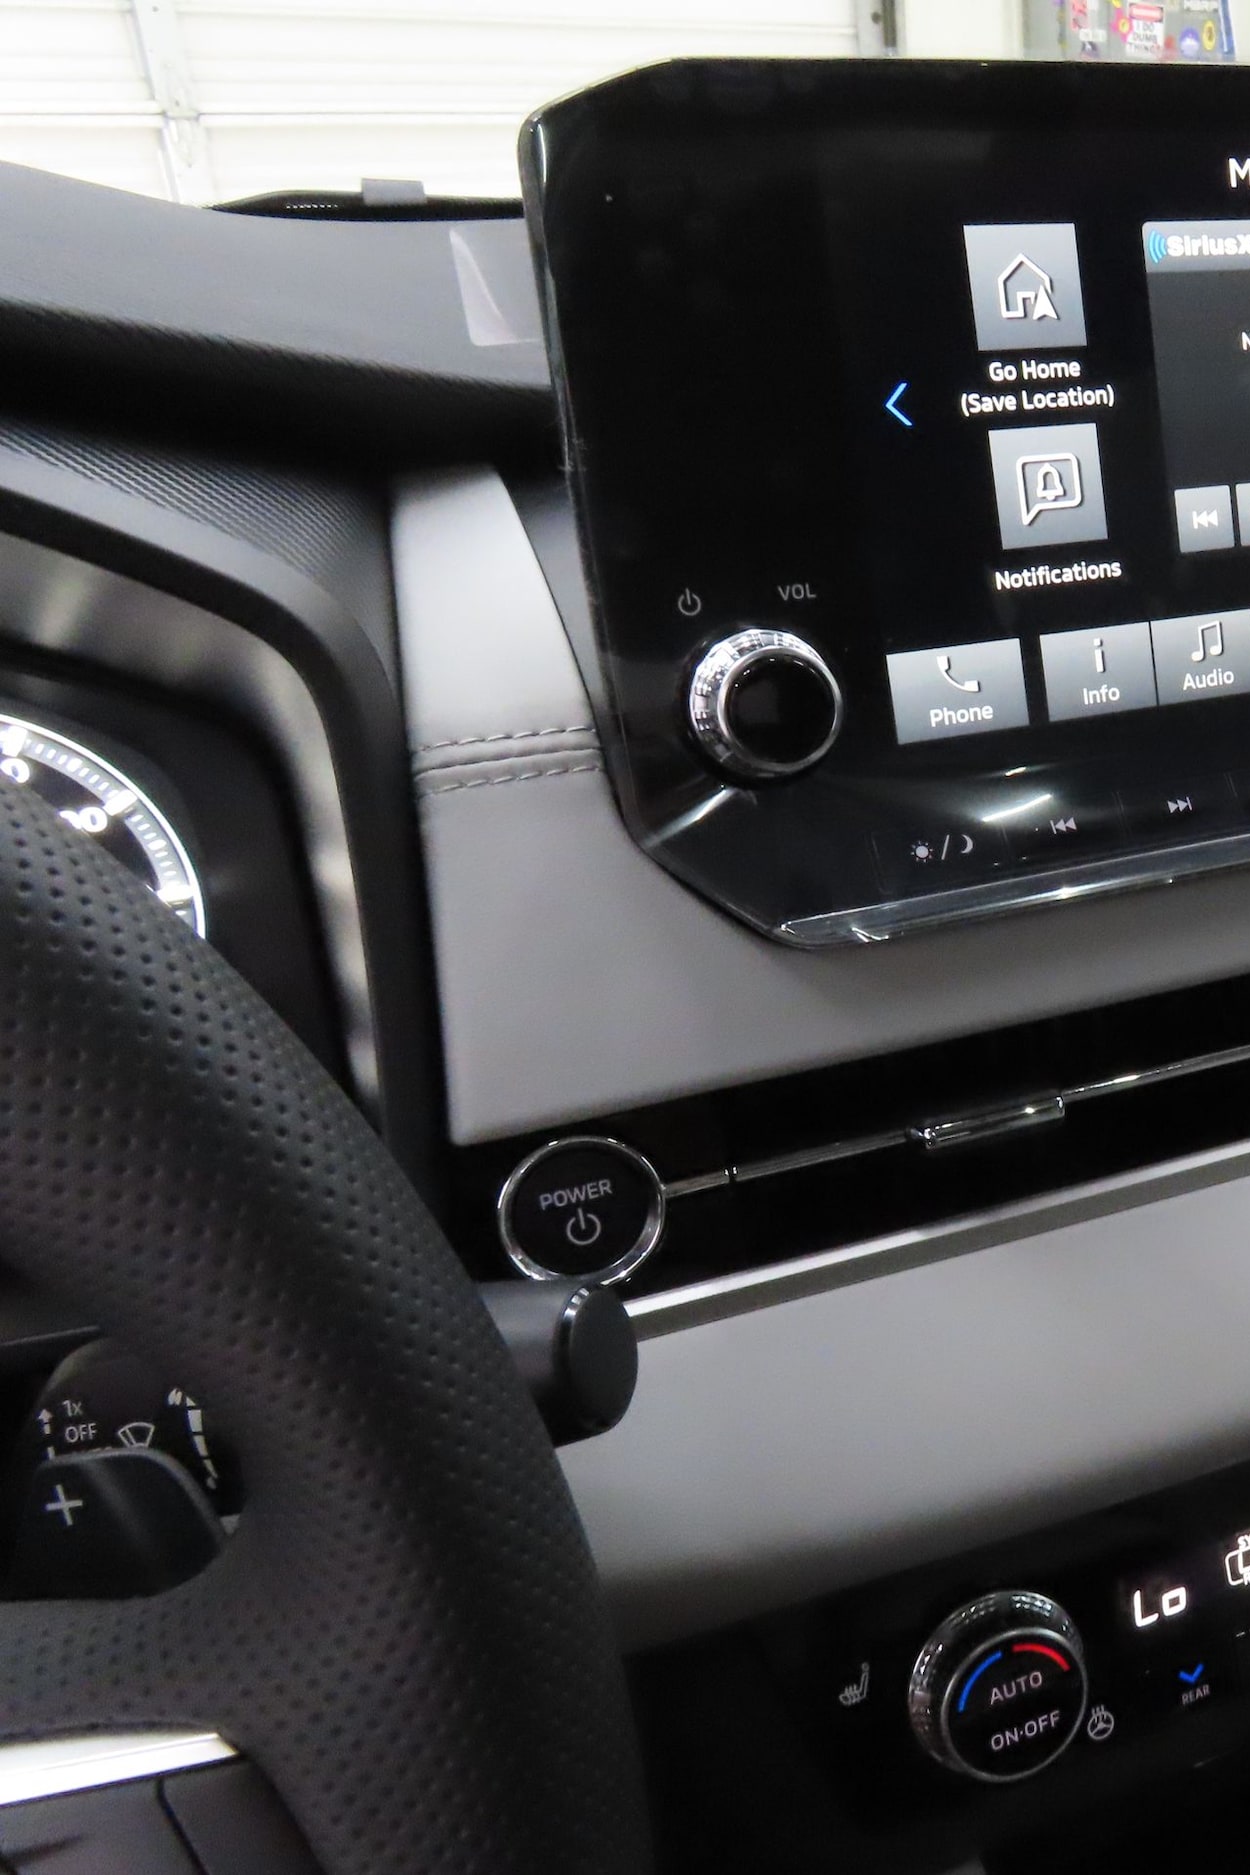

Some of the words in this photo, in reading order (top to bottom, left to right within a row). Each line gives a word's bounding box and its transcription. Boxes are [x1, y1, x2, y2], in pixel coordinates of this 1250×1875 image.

[989, 361, 1017, 382] Go
[1021, 358, 1081, 381] Home
[961, 391, 1017, 417] (Save
[1020, 384, 1115, 411] Location)
[995, 560, 1122, 592] Notifications
[777, 582, 817, 602] VOL
[1182, 668, 1235, 692] Audio
[1083, 685, 1121, 706] Info
[929, 703, 994, 728] Phone
[539, 1179, 613, 1211] POWER
[61, 1399, 83, 1418] 1x
[64, 1422, 97, 1444] OFF
[989, 1670, 1043, 1706] AUTO
[1181, 1683, 1211, 1706] REAR
